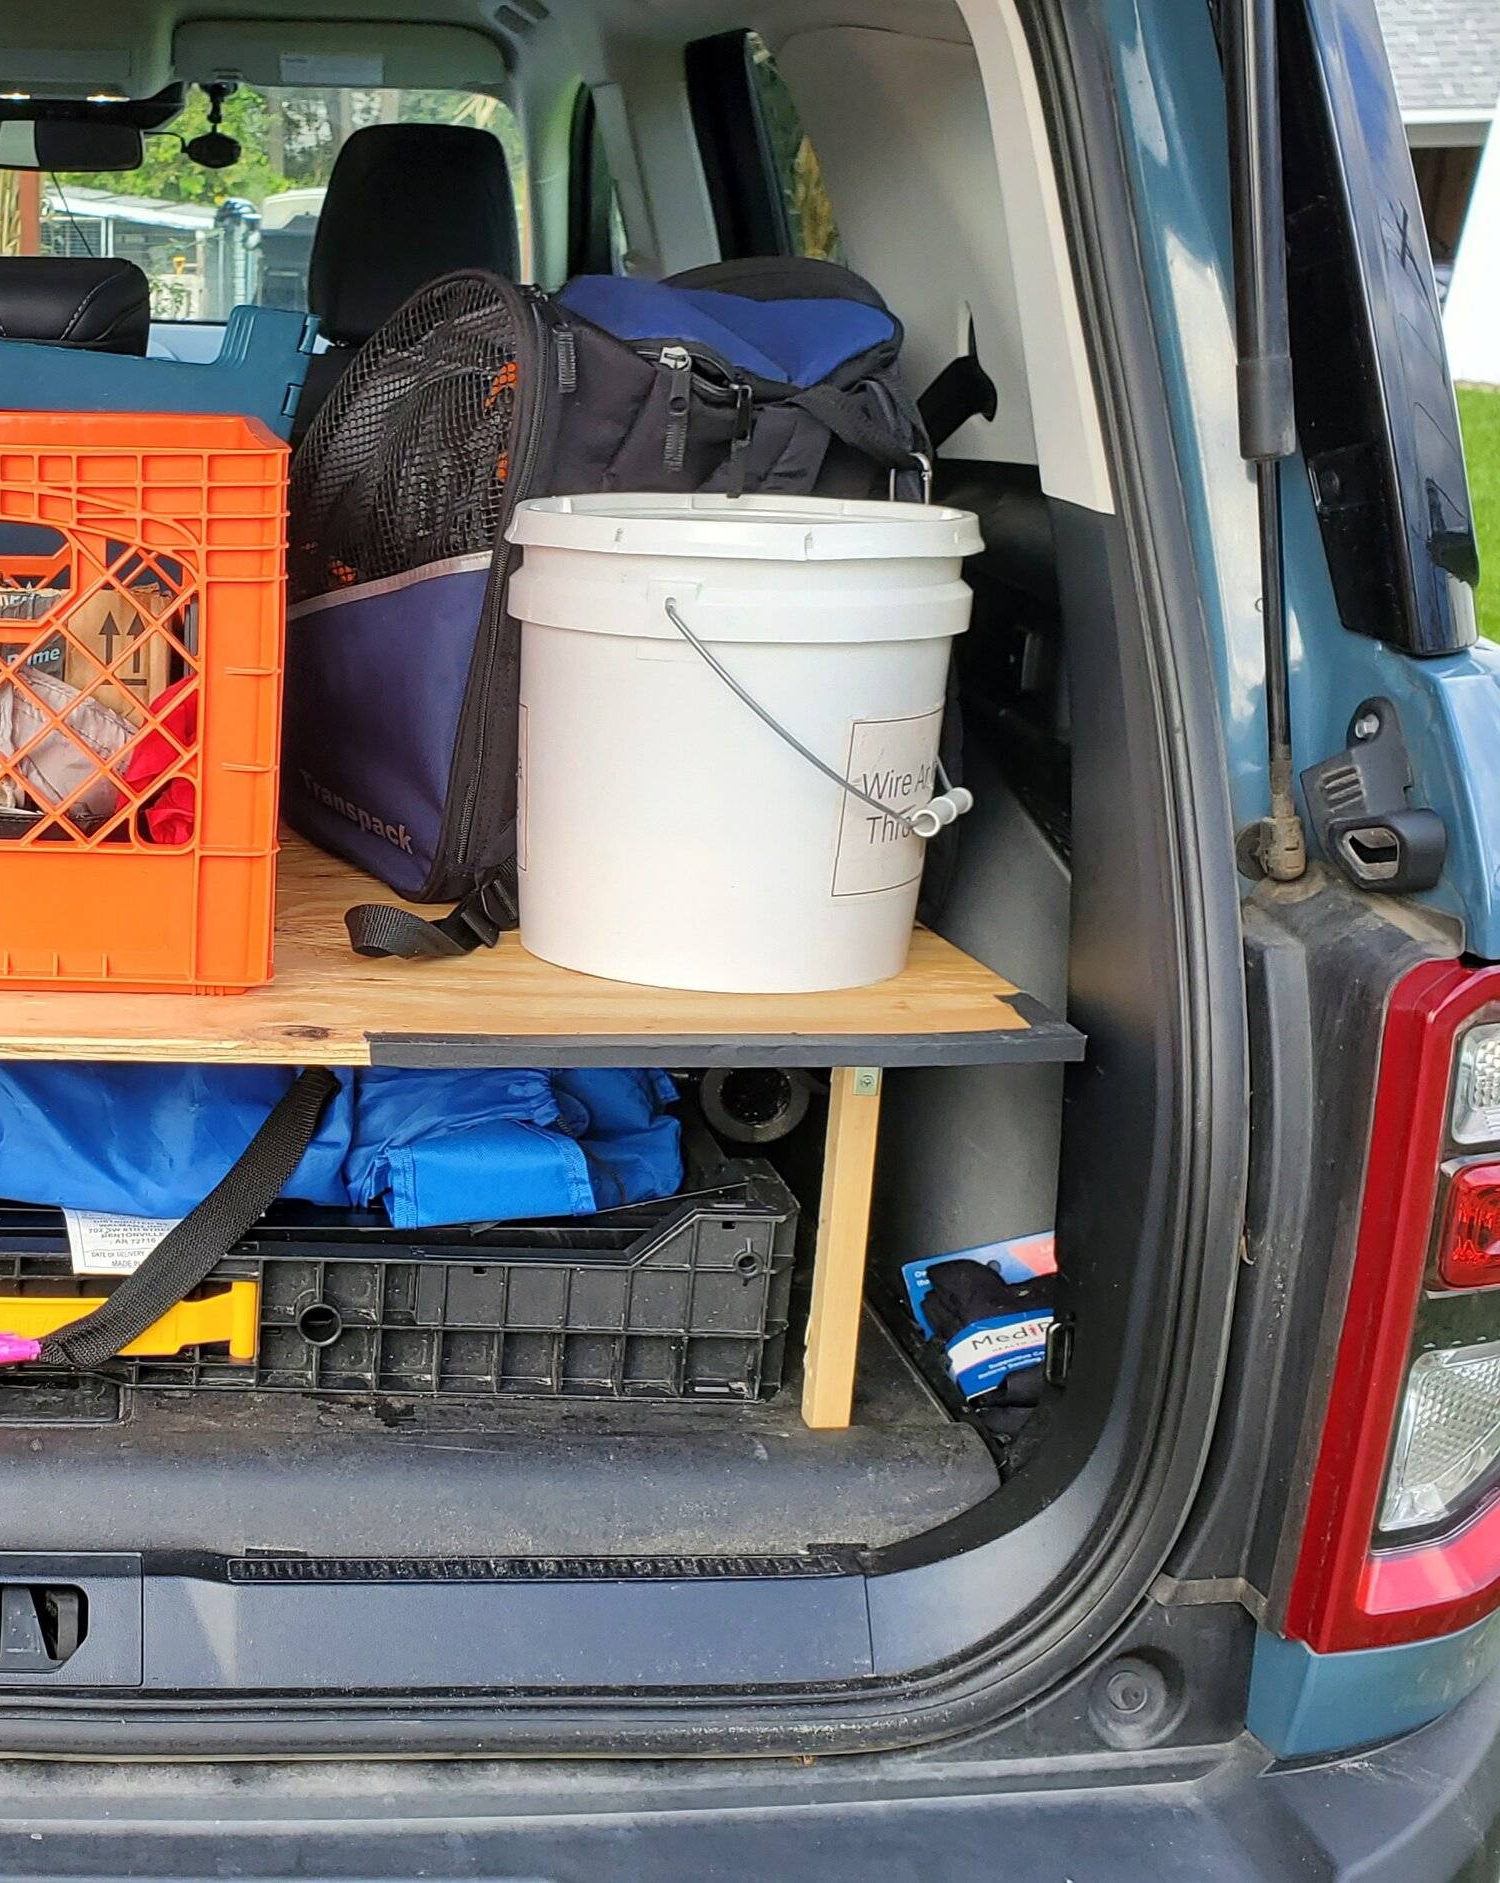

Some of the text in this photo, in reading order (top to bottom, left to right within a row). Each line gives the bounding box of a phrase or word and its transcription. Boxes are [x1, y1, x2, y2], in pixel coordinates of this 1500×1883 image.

[863, 770, 912, 799] Wire
[299, 768, 414, 855] Transpack
[101, 1231, 165, 1239] BENTONVILLE
[116, 1250, 145, 1258] DELIVERY
[972, 1321, 1050, 1350] MediP
